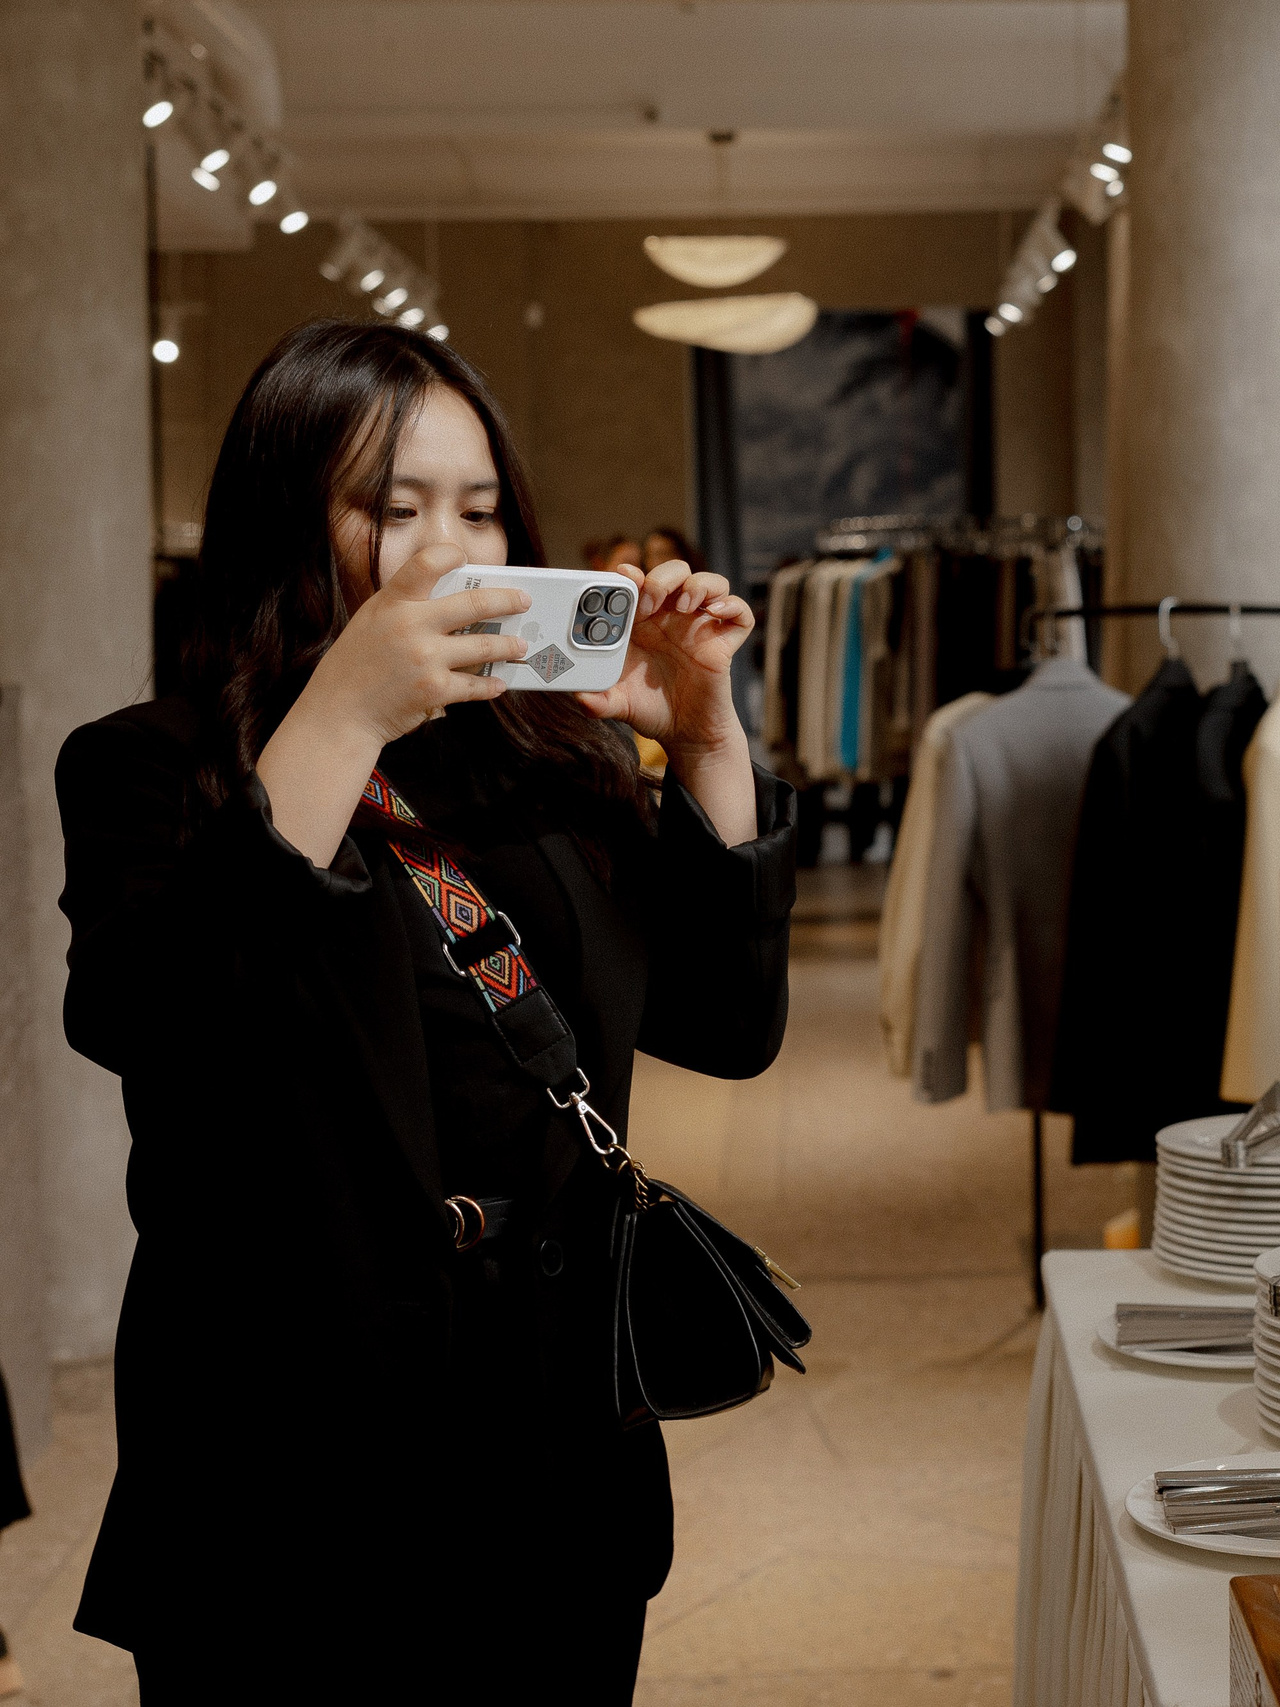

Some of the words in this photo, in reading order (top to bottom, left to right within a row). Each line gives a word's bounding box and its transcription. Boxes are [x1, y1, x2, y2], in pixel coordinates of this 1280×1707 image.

[464, 577, 473, 590] FIRS
[534, 654, 542, 669] POET
[541, 655, 548, 664] OR
[546, 653, 554, 680] MADMAN
[552, 653, 560, 674] EITHER
